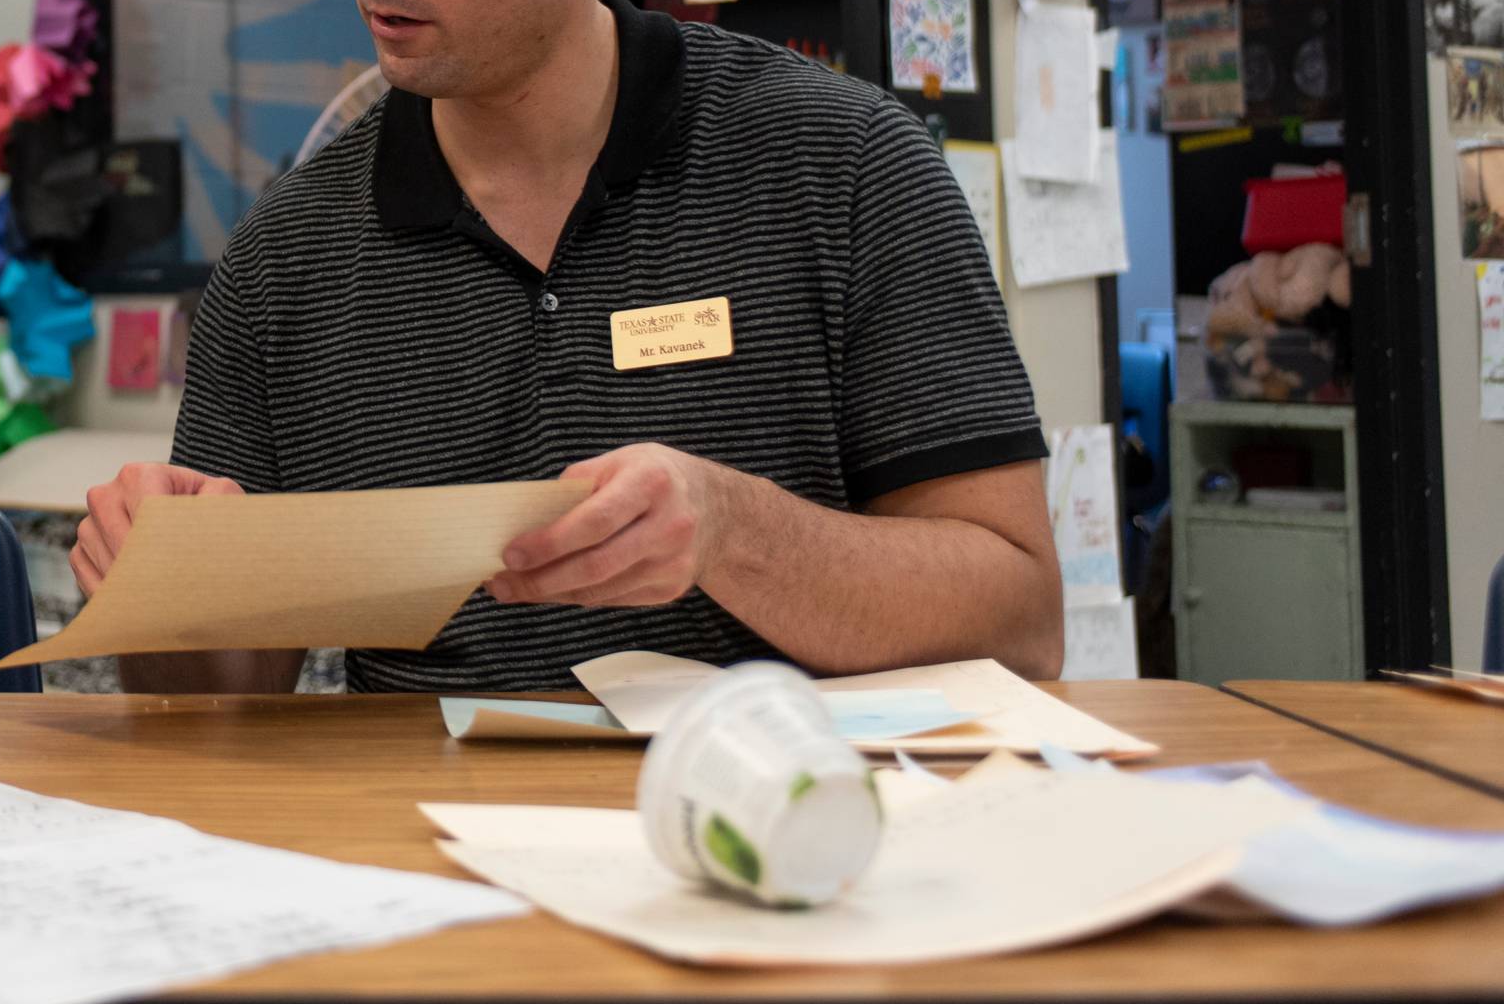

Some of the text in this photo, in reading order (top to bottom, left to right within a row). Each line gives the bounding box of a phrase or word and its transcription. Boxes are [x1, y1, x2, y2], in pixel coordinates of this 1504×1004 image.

[619, 313, 685, 331] TEXAS STATE
[630, 324, 675, 337] UNIVERSITY
[640, 340, 706, 358] Mr. Kavanek
